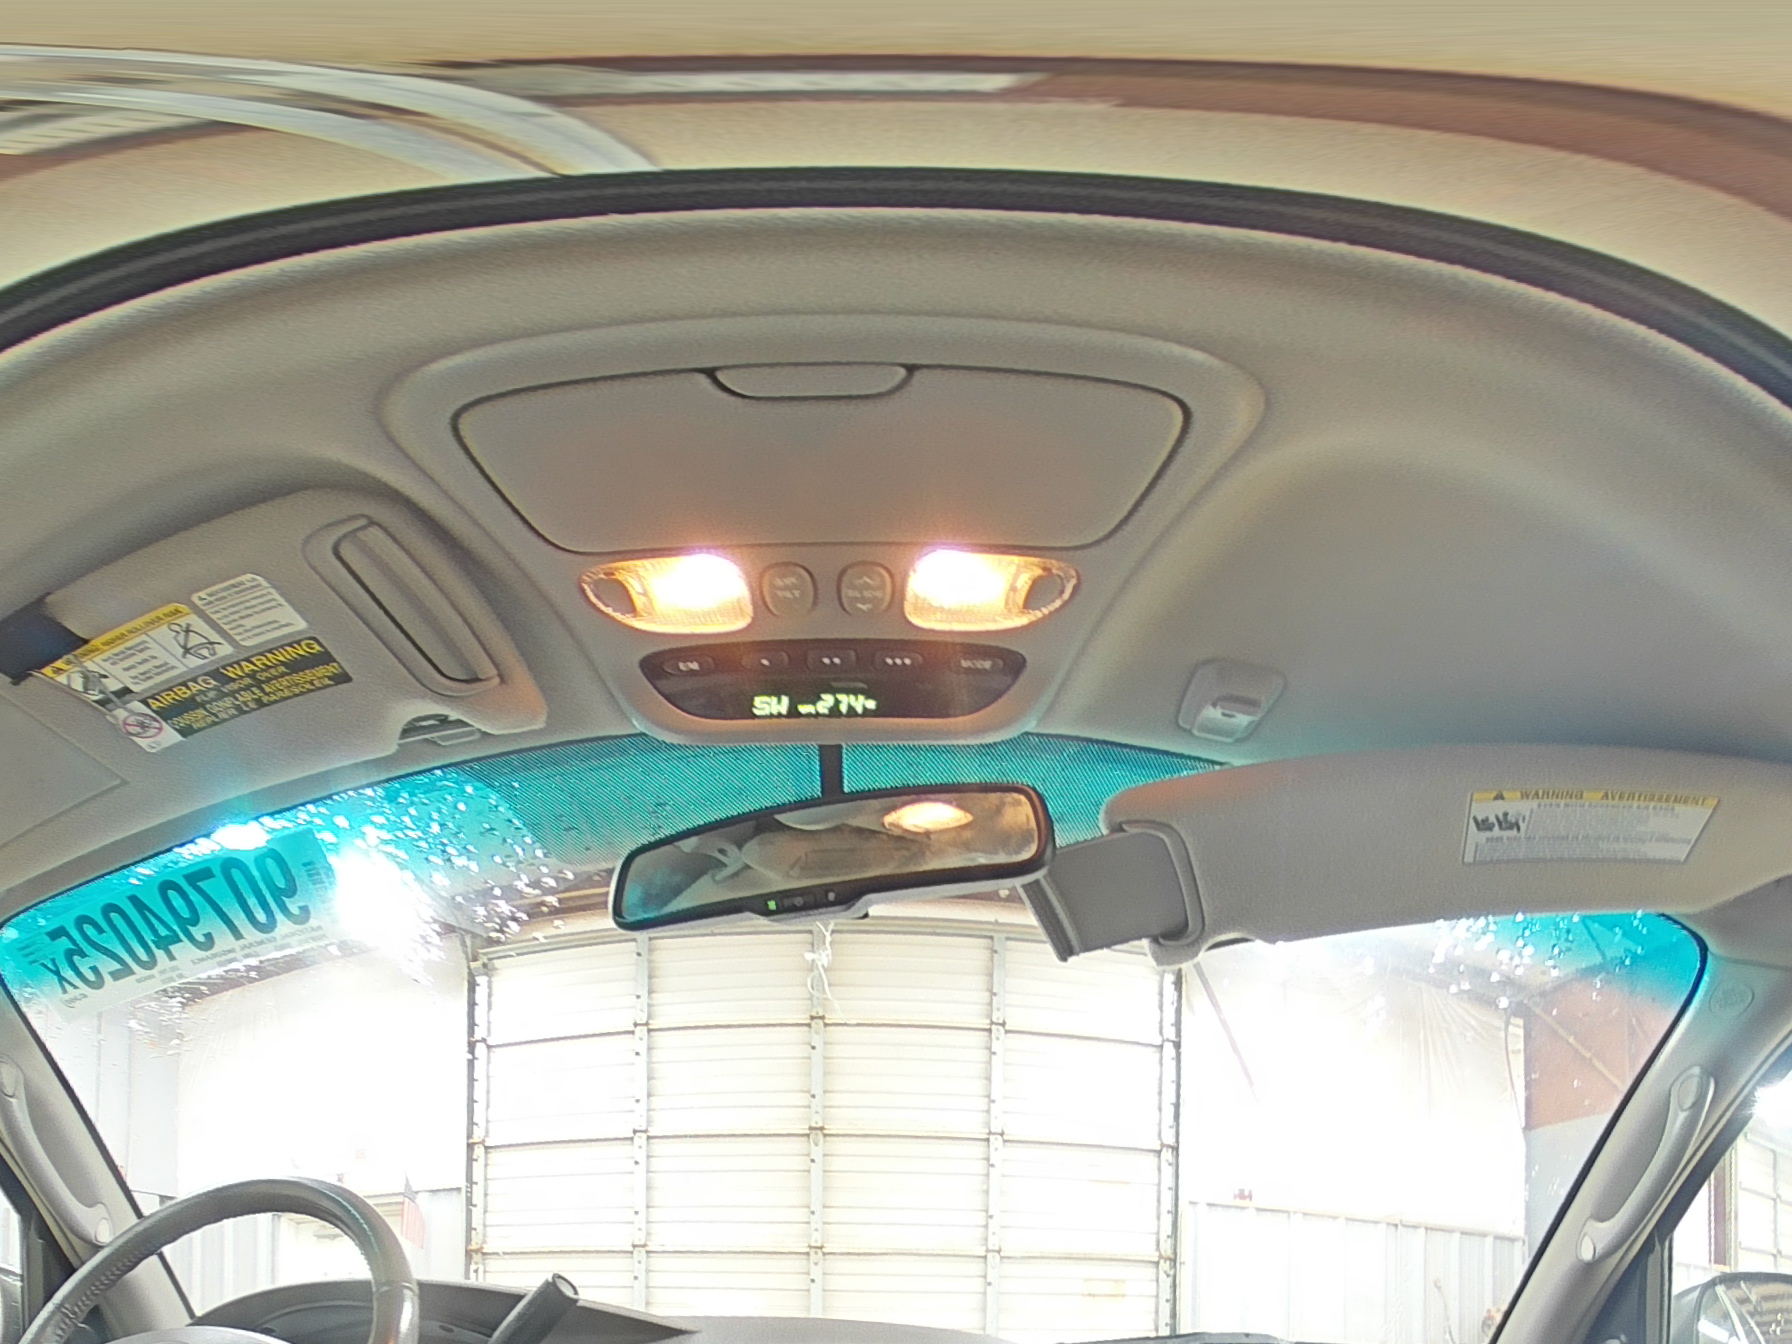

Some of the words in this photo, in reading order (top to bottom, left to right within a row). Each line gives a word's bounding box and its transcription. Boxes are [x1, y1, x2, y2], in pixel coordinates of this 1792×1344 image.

[146, 674, 221, 711] AIRBAG
[220, 639, 325, 680] WARNING
[752, 694, 790, 715] SW
[1520, 790, 1585, 800] WARNING
[1600, 791, 1706, 806] AVERTISSEMENT
